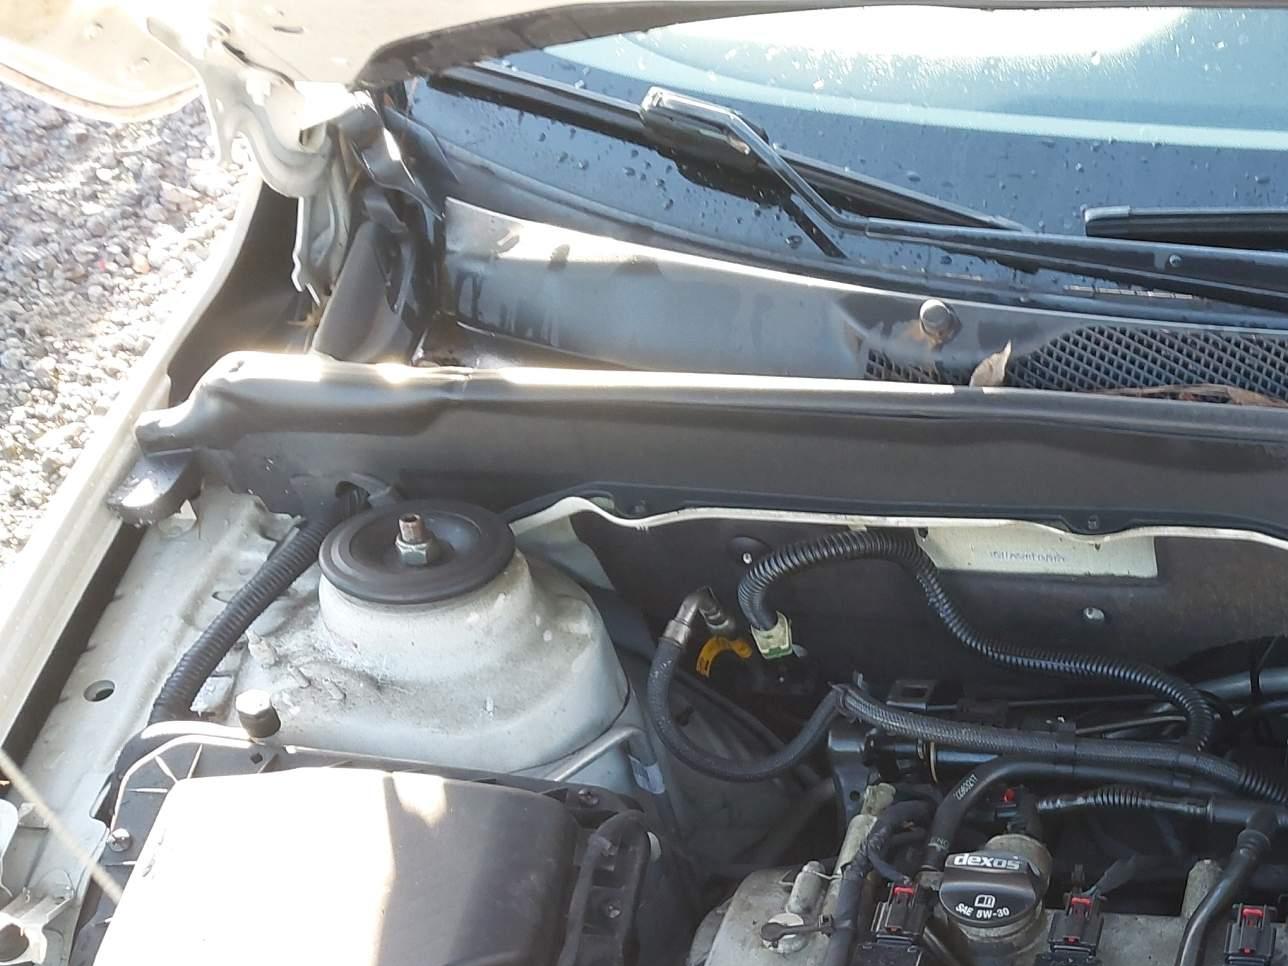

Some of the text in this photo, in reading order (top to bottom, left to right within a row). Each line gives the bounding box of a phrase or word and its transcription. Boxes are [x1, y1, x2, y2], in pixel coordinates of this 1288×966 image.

[954, 853, 1021, 870] dexos
[955, 902, 1010, 919] SAE 5W-30
